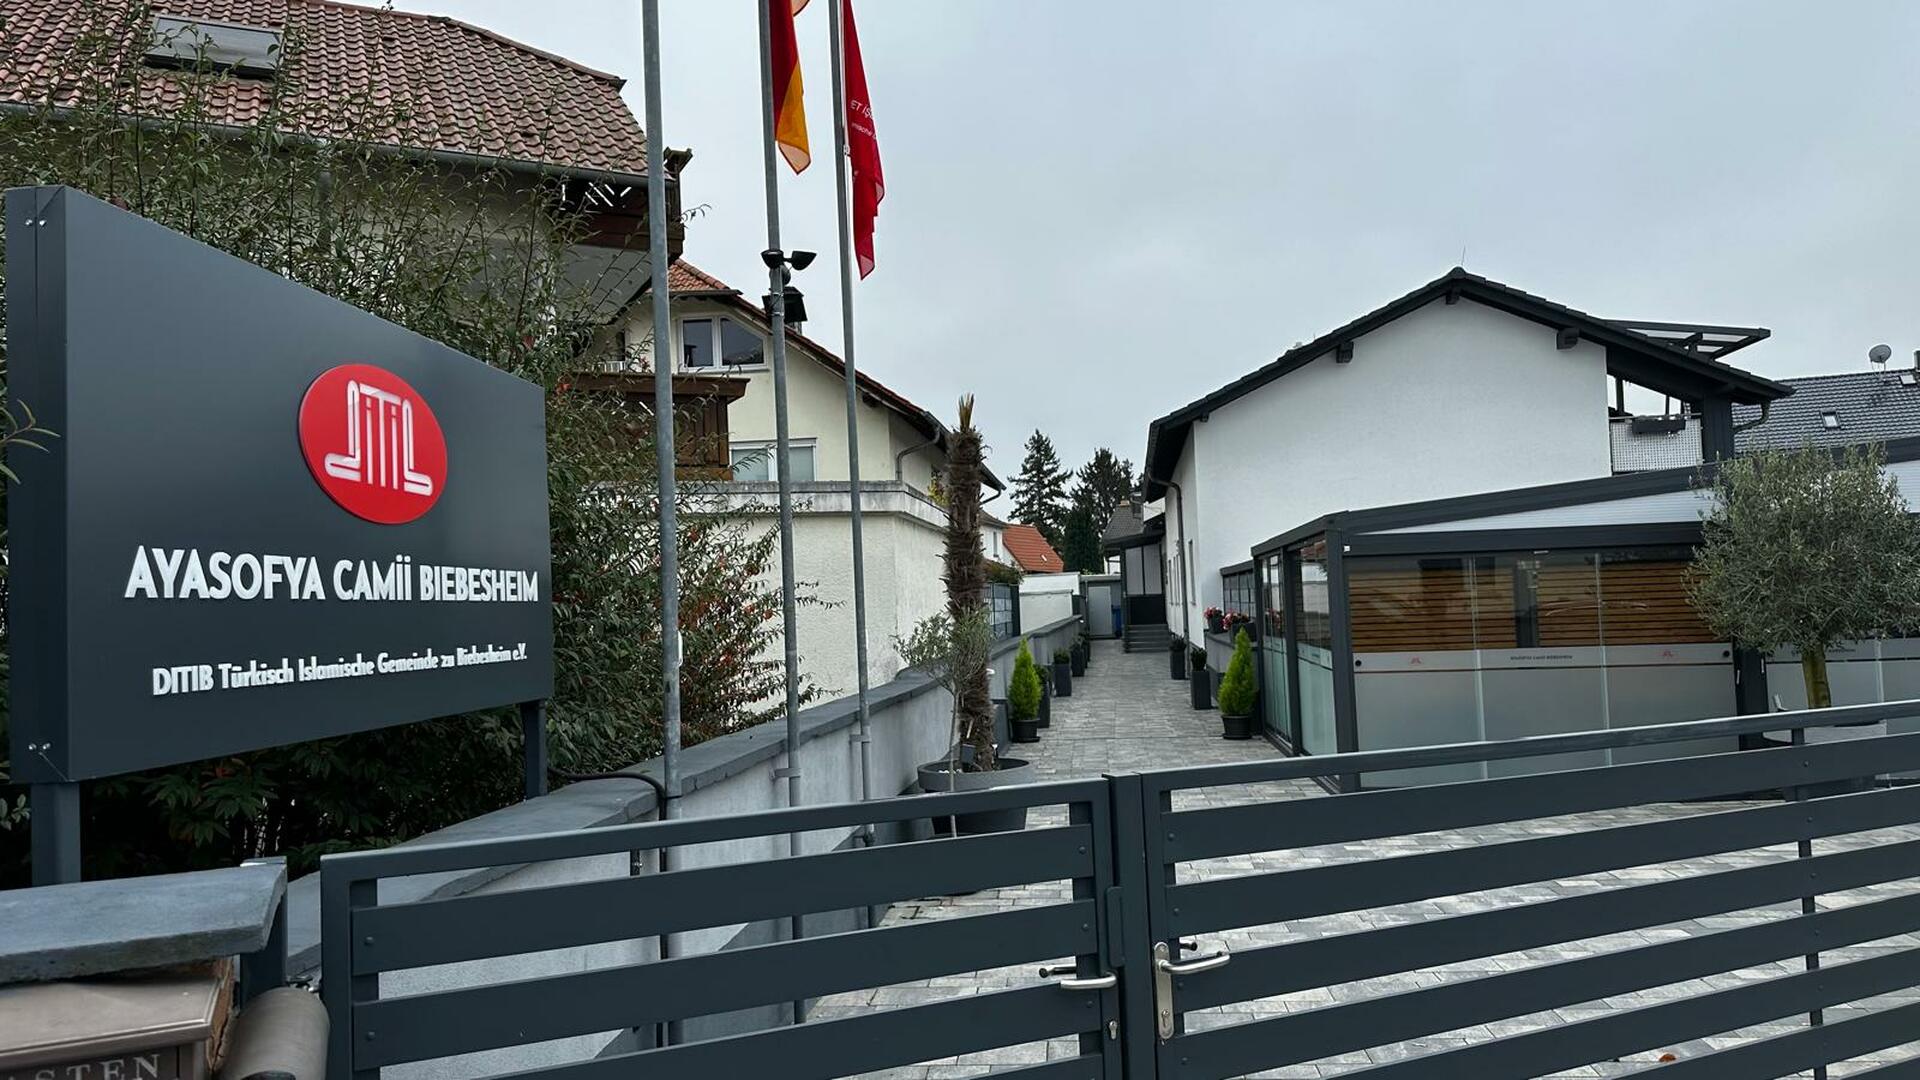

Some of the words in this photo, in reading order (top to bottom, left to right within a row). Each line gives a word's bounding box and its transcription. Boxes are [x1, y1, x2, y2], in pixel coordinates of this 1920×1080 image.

[125, 545, 325, 599] AYASOFYA
[420, 565, 538, 601] BIEBESHEIM
[153, 665, 214, 695] DITIB
[218, 658, 294, 688] Türkisch
[299, 653, 375, 681] Islamische
[377, 648, 438, 673] Gemeinde
[441, 655, 455, 667] zu
[457, 644, 511, 665] Biebesheim
